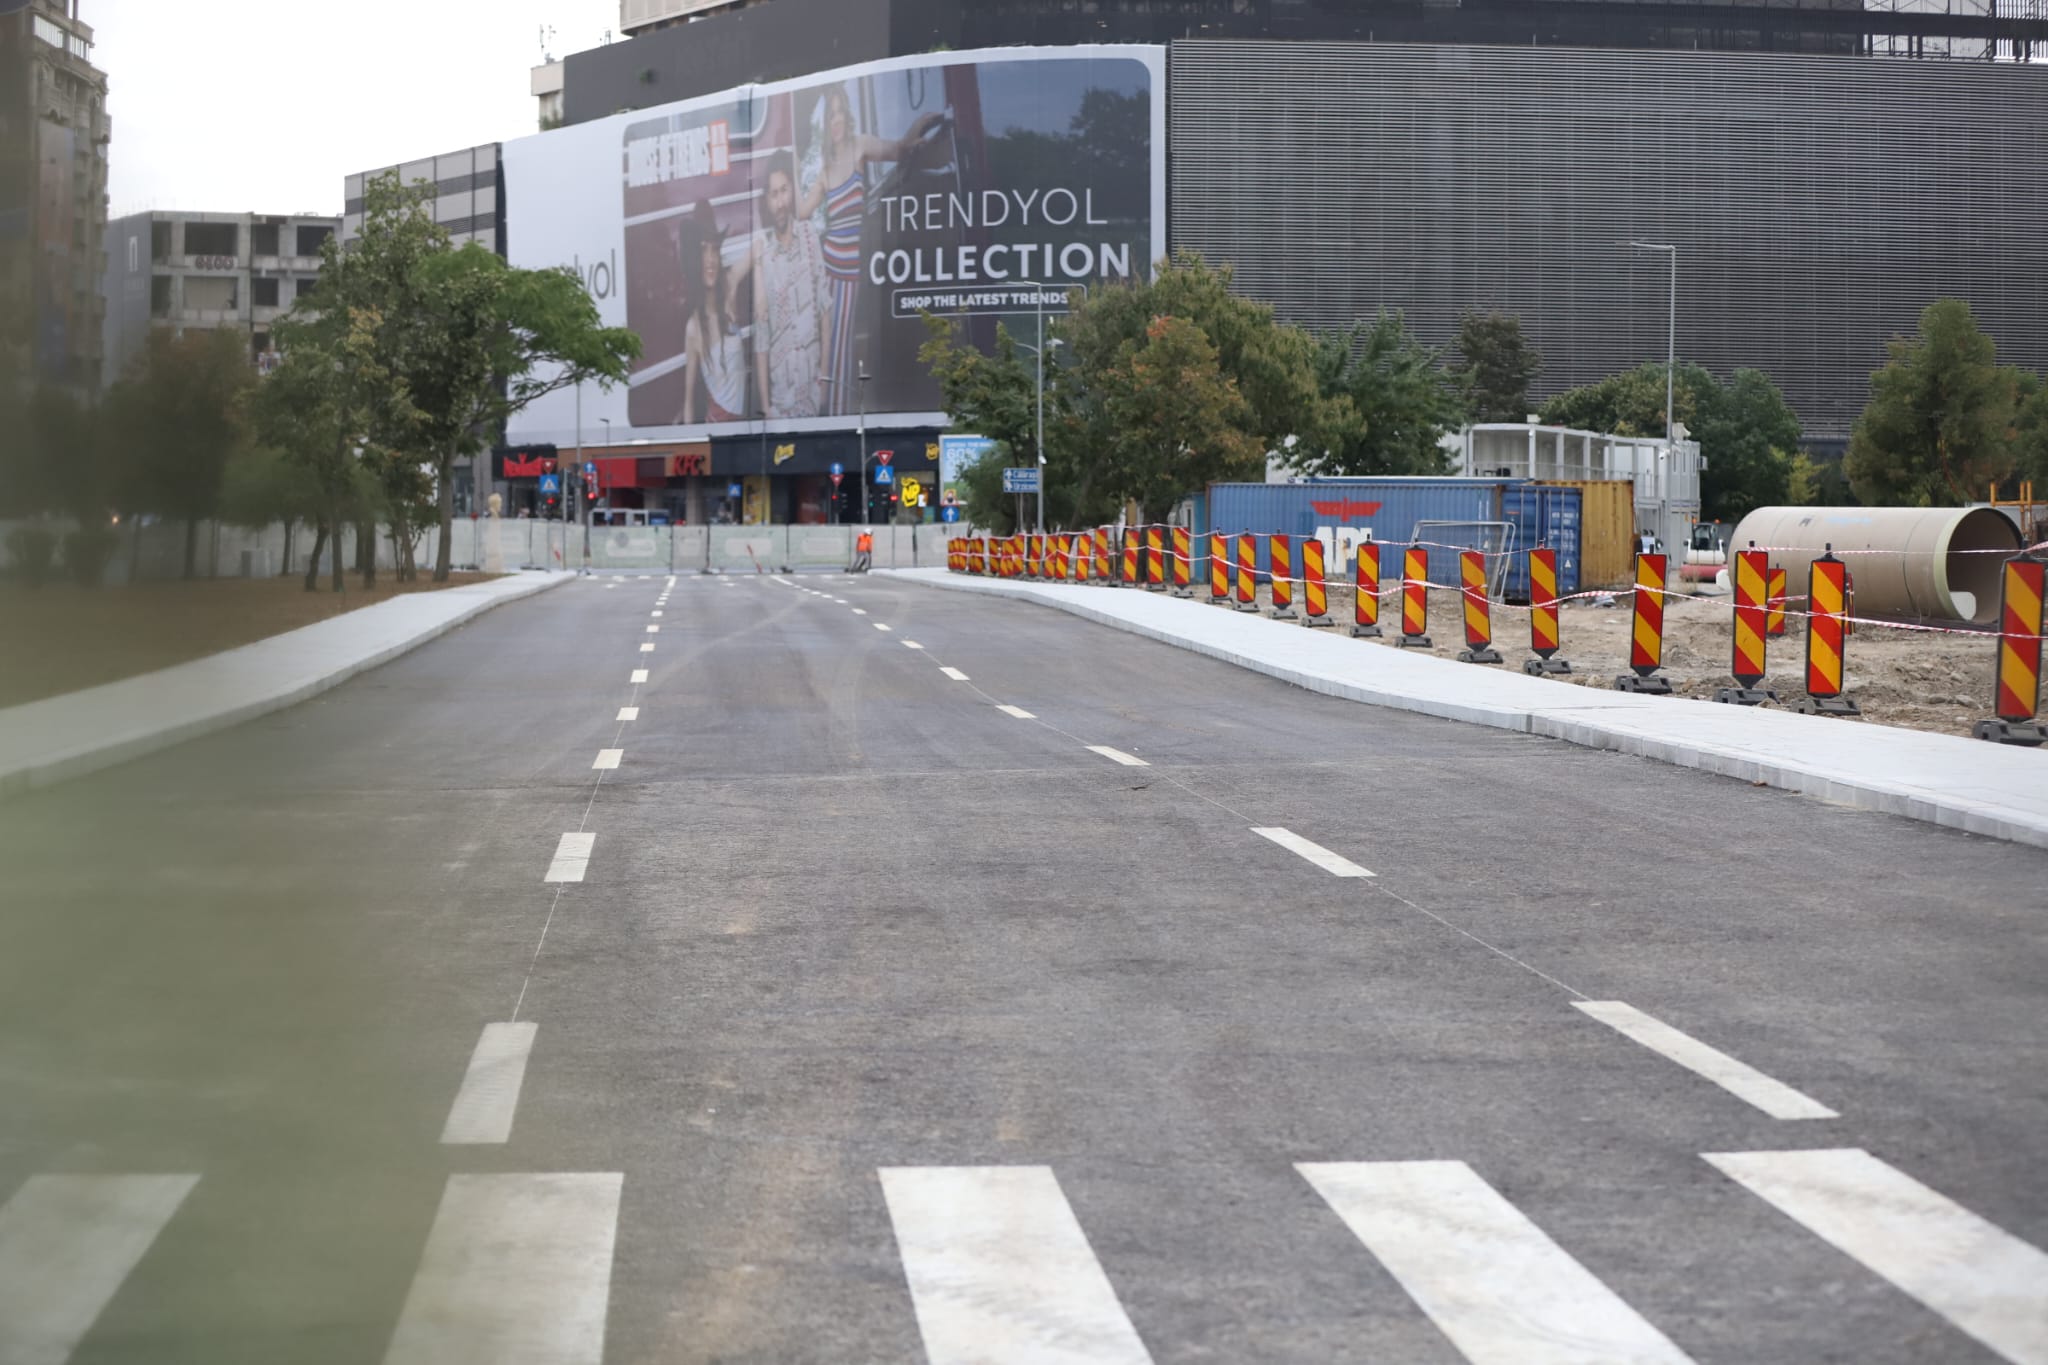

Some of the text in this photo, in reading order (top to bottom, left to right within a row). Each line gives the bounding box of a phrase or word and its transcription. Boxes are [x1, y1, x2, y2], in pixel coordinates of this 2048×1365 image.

[881, 188, 1108, 232] TRENDYOL
[870, 243, 1129, 285] COLLECTION
[900, 292, 1070, 309] SHOP THE LATEST TRENDS
[672, 455, 705, 476] KFC
